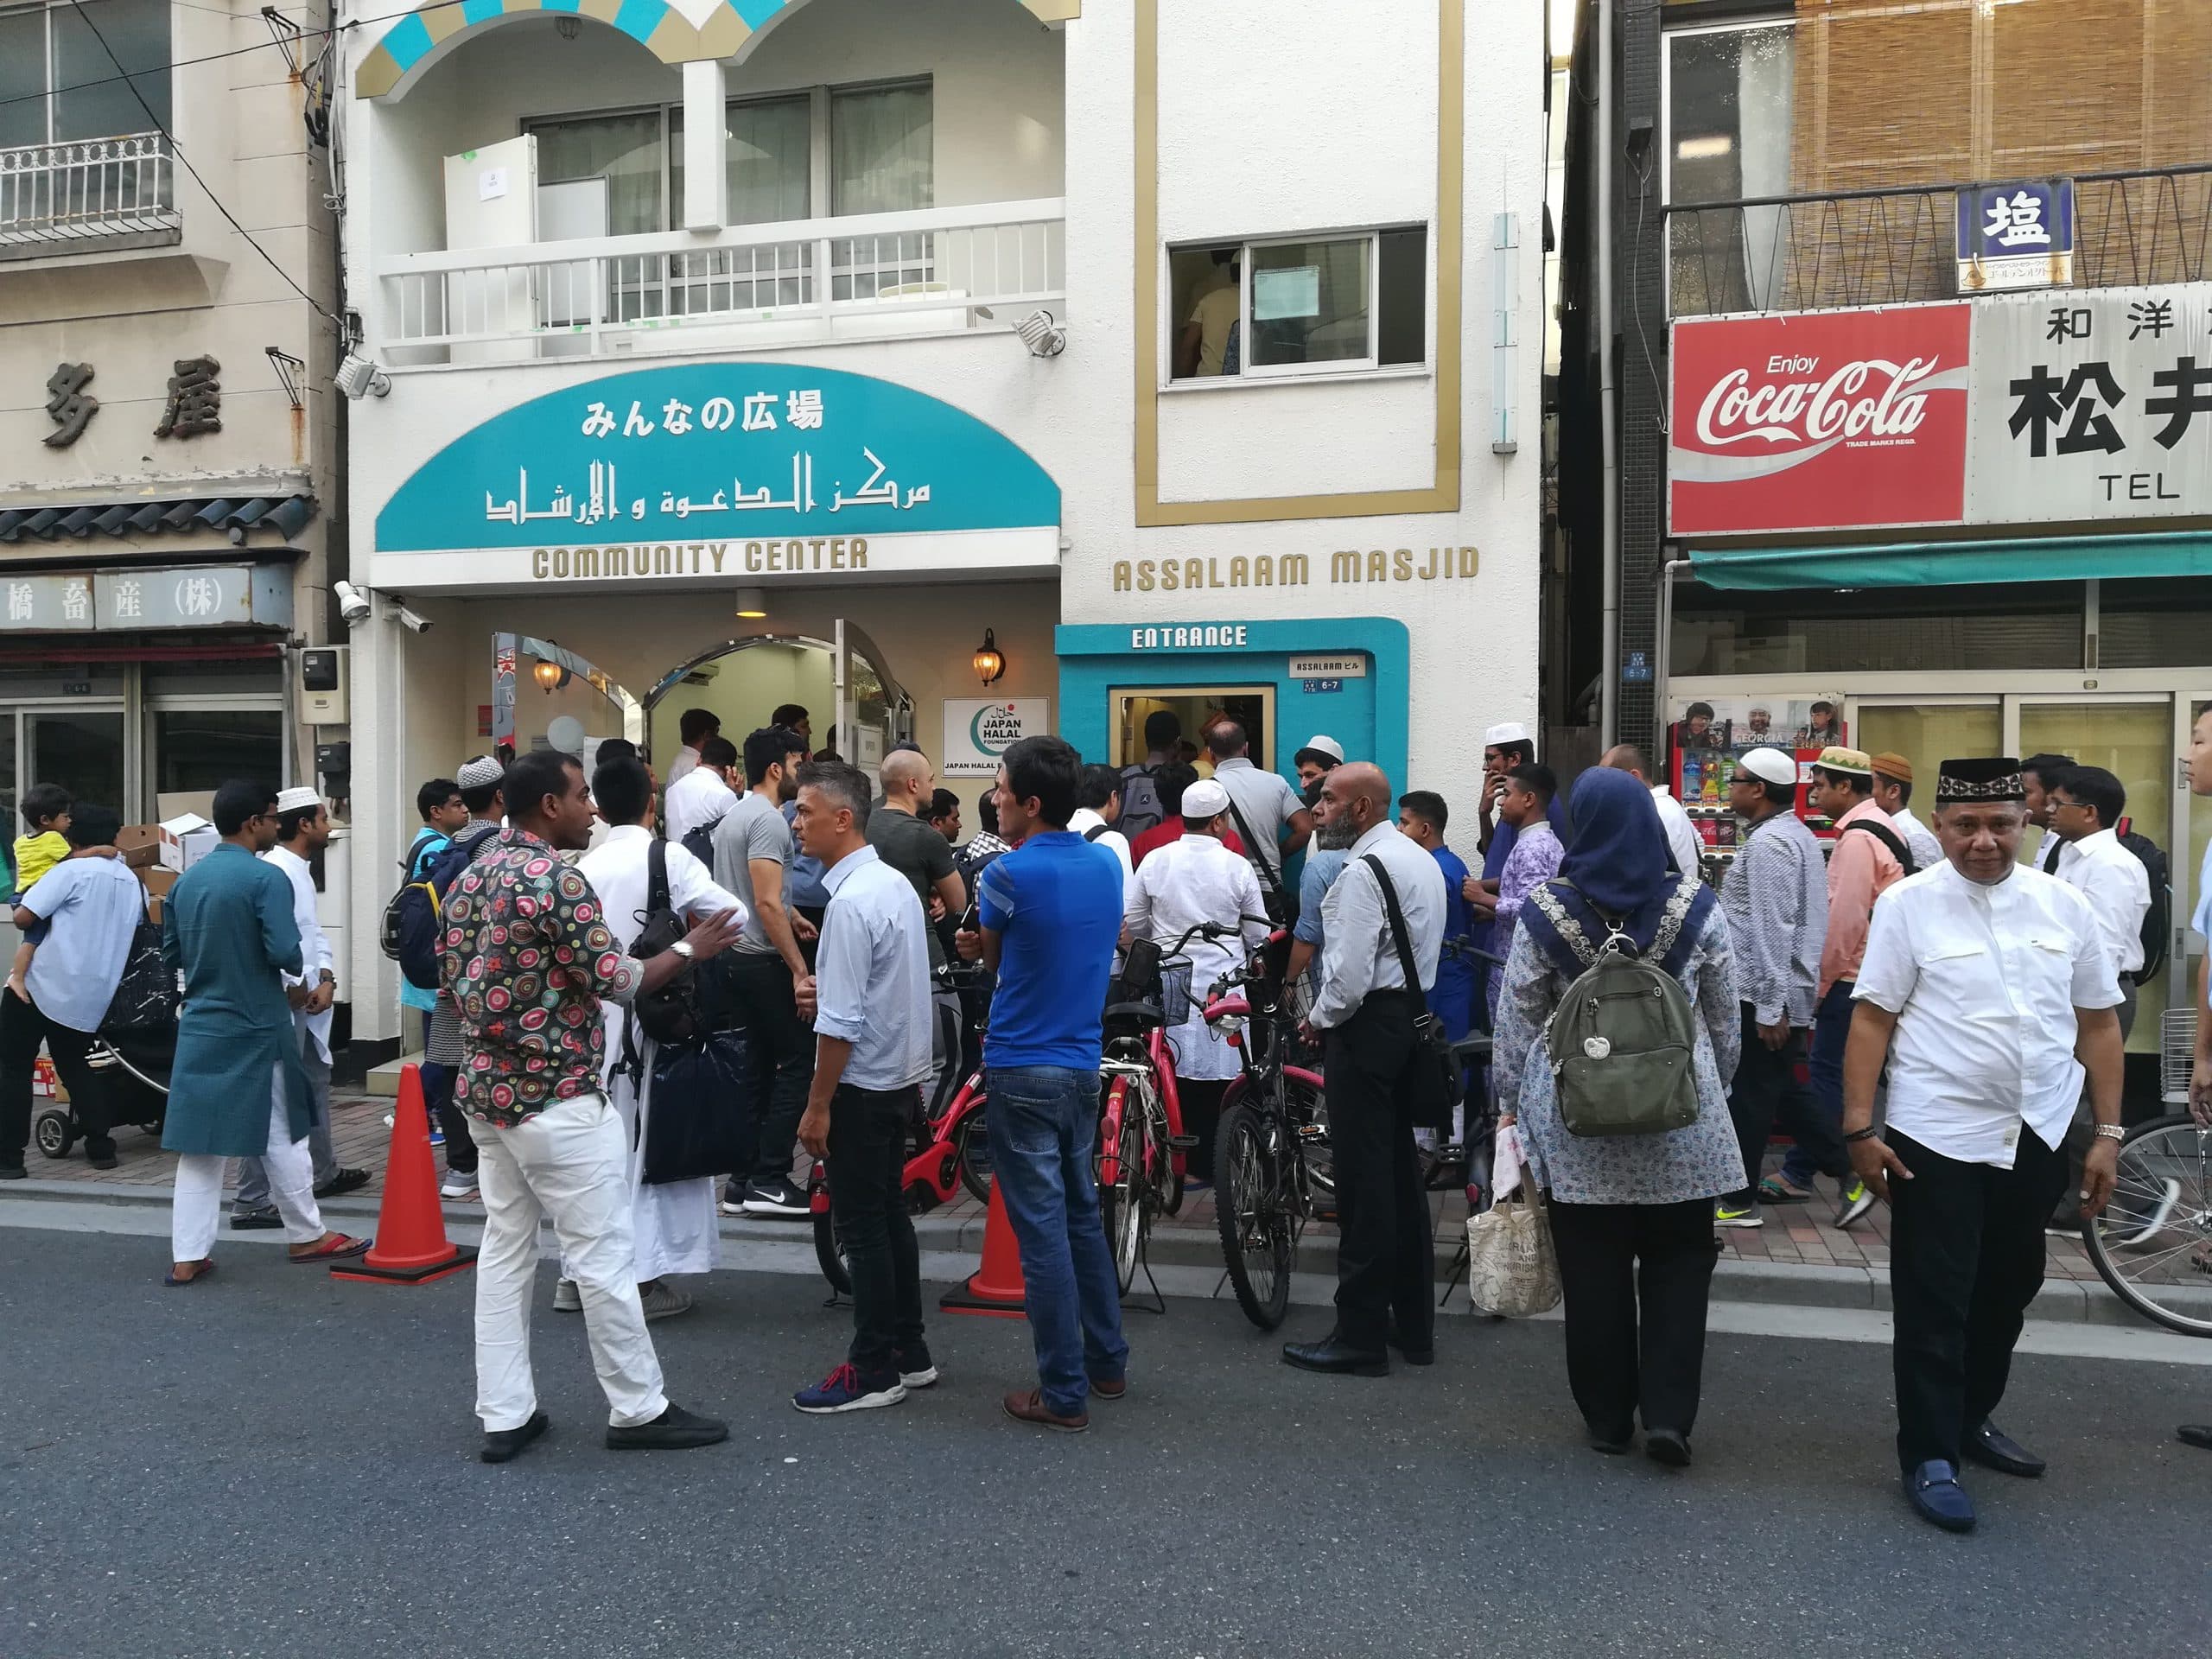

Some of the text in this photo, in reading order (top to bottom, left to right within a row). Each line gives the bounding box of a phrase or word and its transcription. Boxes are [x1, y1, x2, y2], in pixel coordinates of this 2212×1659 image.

[1983, 191, 2051, 246] 塩
[2046, 299, 2212, 344] 和洋
[1767, 354, 1819, 374] Enjoy
[1697, 354, 1938, 445] Coca-Cola
[582, 390, 824, 438] みんなの広場
[828, 446, 931, 512] مركز
[2099, 473, 2180, 501] TEL
[631, 497, 645, 520] و
[532, 538, 868, 579] COMMUNITY CENTER
[1113, 546, 1479, 592] ASSALAAM MASJID
[1132, 626, 1247, 649] ENTRANCE
[1321, 681, 1338, 690] 6-7
[983, 719, 1020, 728] JAPAN
[983, 729, 1020, 738] HALAL
[1735, 733, 1783, 743] GEORGIA
